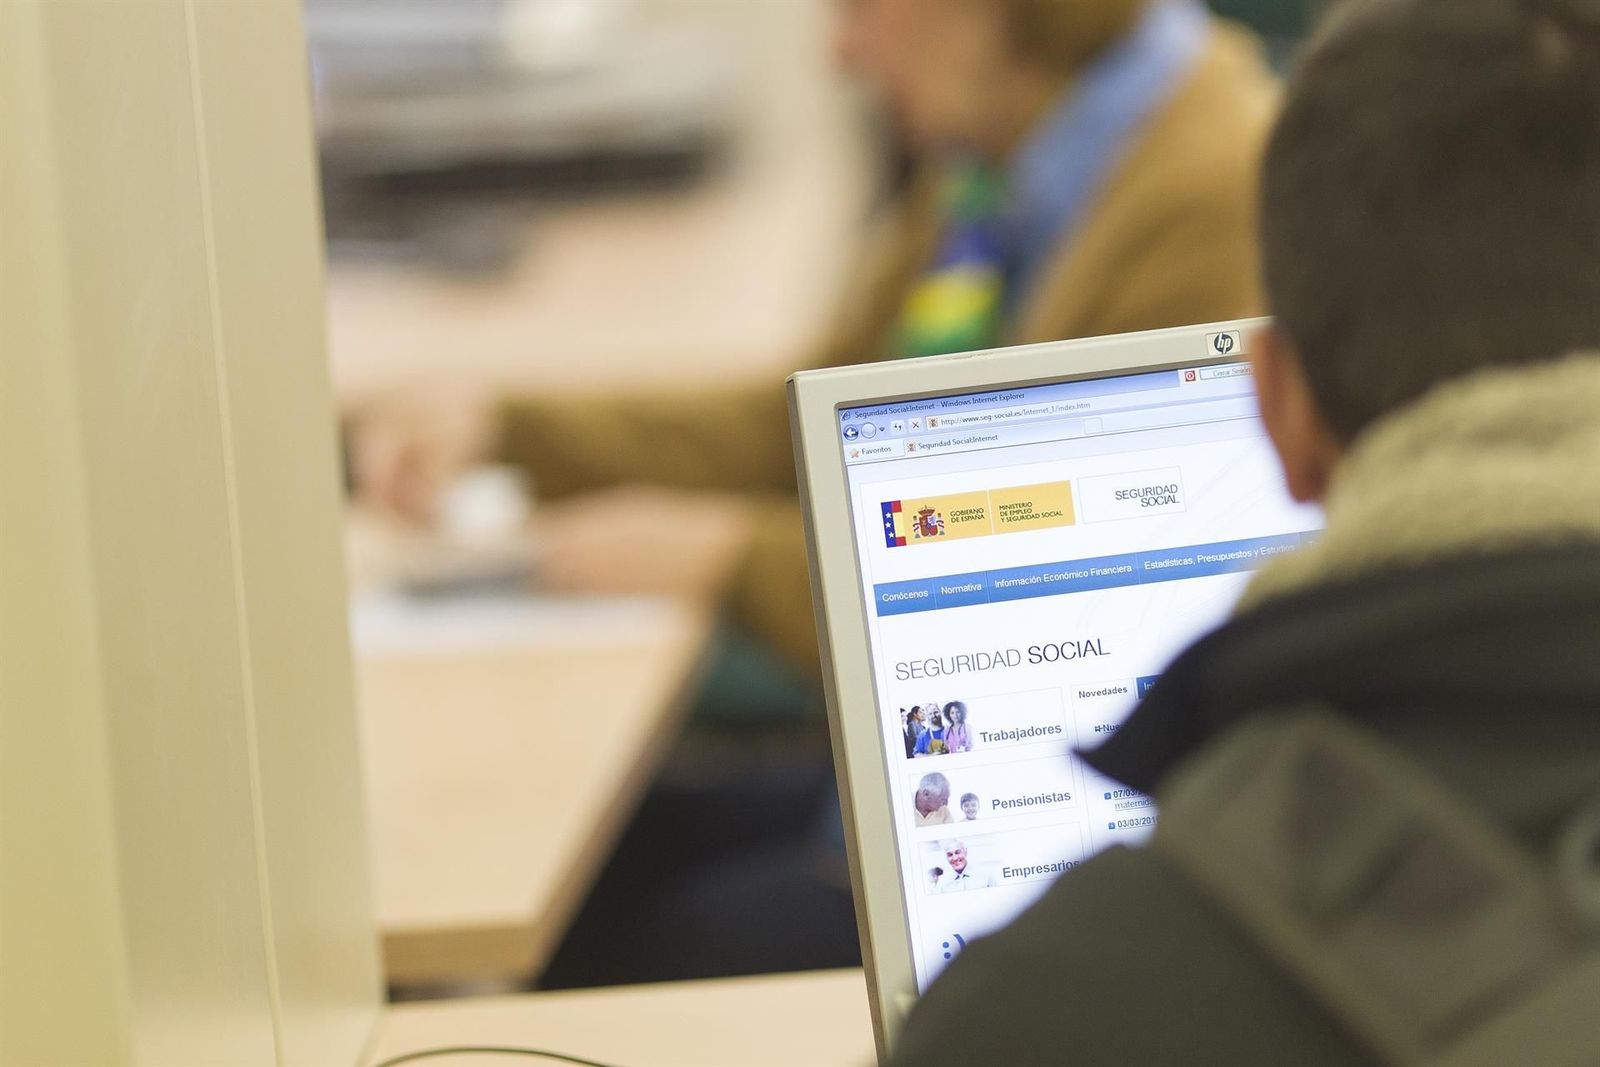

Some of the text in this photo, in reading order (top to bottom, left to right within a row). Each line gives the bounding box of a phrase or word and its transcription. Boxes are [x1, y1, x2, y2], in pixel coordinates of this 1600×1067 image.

[1214, 332, 1233, 354] hp
[854, 407, 888, 418] Seguridad
[941, 399, 972, 408] Windows
[972, 395, 998, 404] Internet
[1000, 392, 1025, 402] Explorer
[862, 446, 892, 455] Favoritos
[918, 439, 951, 450] Seguridad
[1115, 484, 1179, 500] SEGURIDAD
[999, 502, 1032, 511] MINISTERIO
[1140, 494, 1180, 508] SOCIAL
[950, 507, 984, 518] GOBIERNO
[960, 513, 985, 523] ESPAÑA
[1006, 514, 1040, 522] SEGURIDAD
[1041, 511, 1063, 519] SOCIAL
[1009, 508, 1032, 516] EMPLEO
[1144, 556, 1196, 570] Estadísticas,
[1197, 550, 1252, 564] Presupuestos
[994, 564, 1132, 588] Información Económico Financiera
[882, 589, 928, 602] Conócenos
[941, 582, 982, 596] Normativa
[895, 638, 1111, 682] SEGURIDAD SOCIAL
[1078, 686, 1128, 699] Novedades
[980, 722, 1062, 744] Trabajadores
[992, 790, 1072, 810] Pensionistas
[1002, 860, 1080, 878] Empresarios
